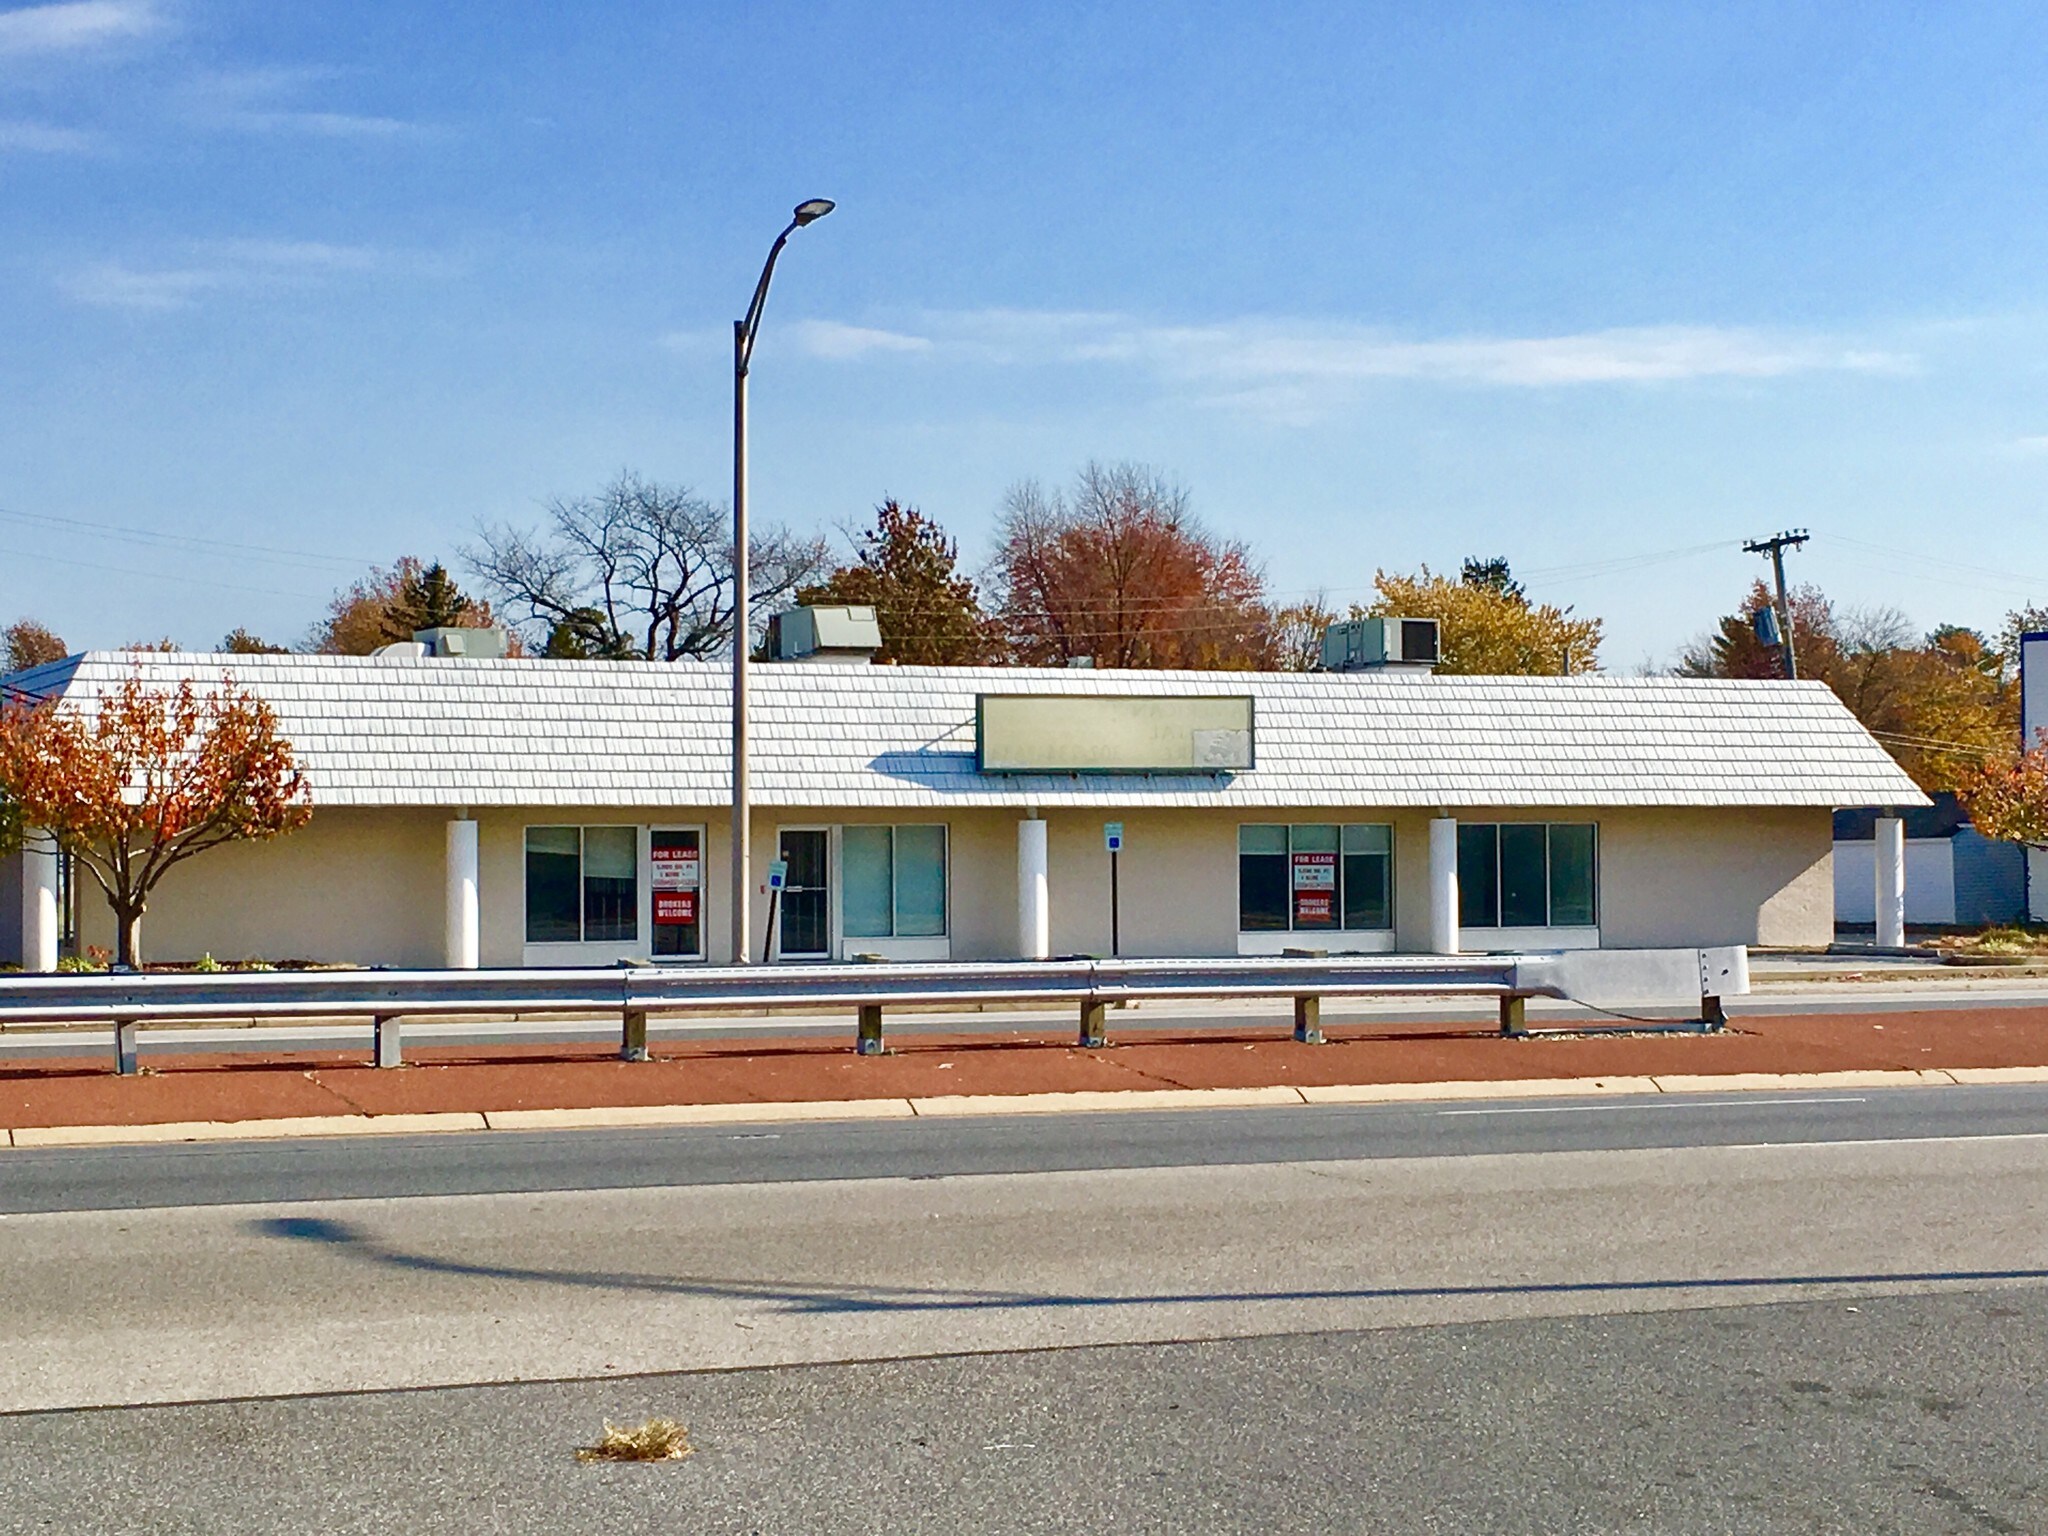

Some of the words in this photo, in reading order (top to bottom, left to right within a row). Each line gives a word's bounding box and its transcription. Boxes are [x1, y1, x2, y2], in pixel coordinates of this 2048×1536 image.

[653, 850, 669, 858] FOR
[672, 850, 698, 858] LEASE
[658, 900, 692, 908] BROKERS
[658, 909, 692, 917] WELCOME
